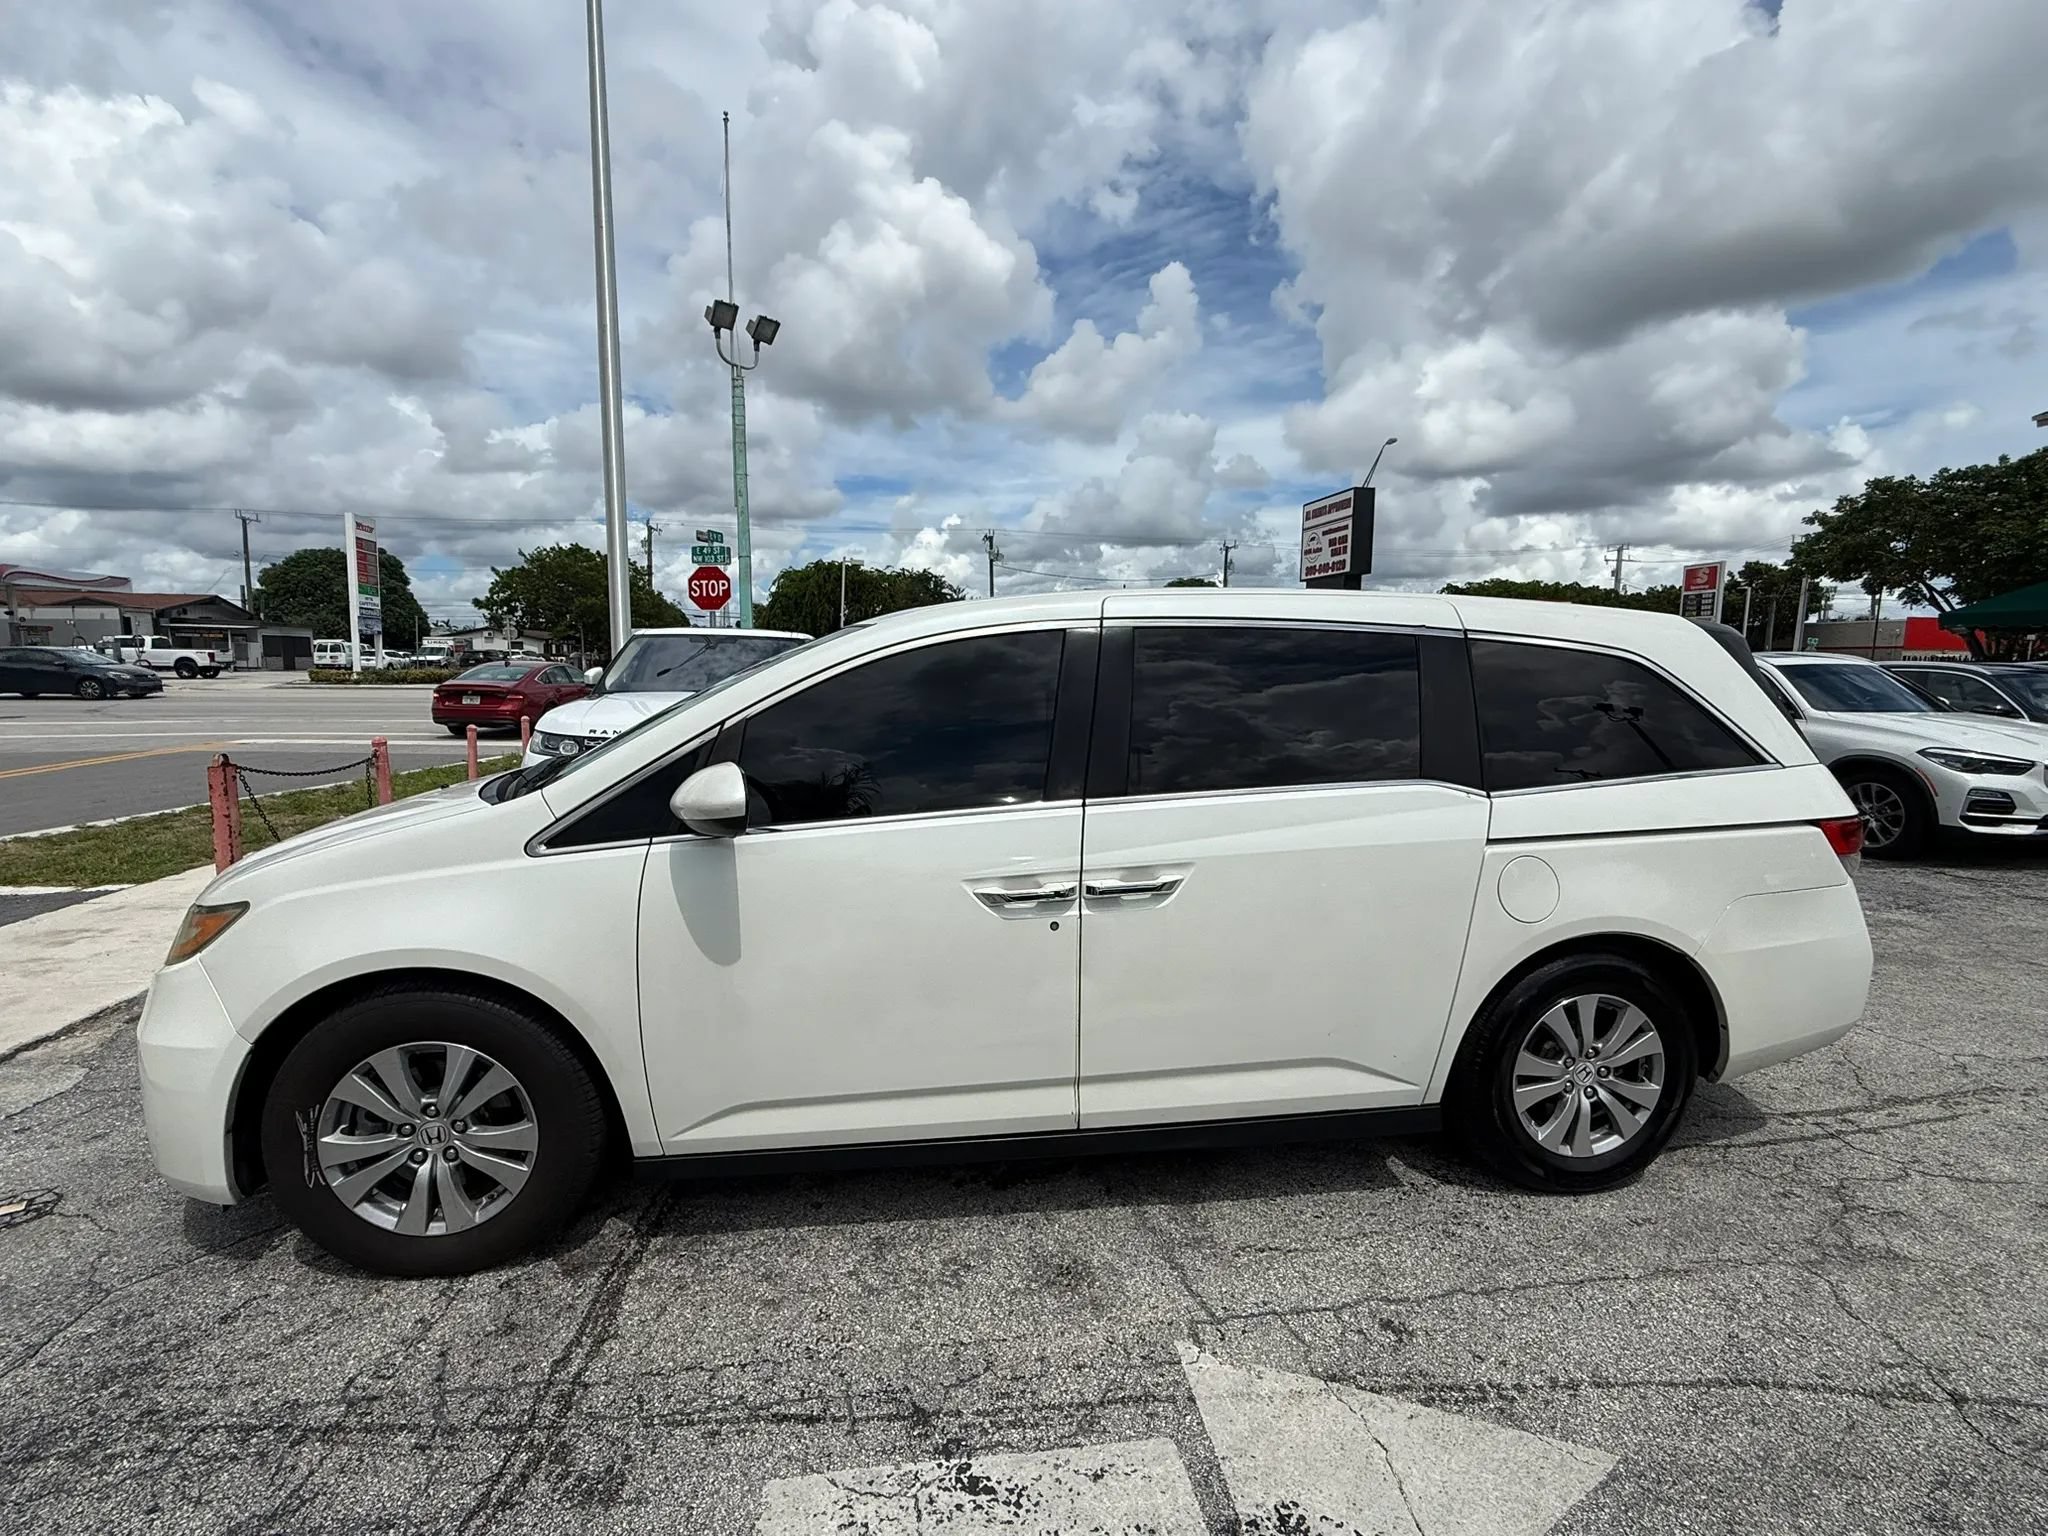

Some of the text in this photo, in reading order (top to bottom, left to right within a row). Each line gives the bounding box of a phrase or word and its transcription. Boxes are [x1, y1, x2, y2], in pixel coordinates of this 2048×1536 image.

[696, 547, 701, 555] E
[713, 547, 720, 555] ST
[716, 555, 724, 563] ST
[691, 580, 728, 597] STOP
